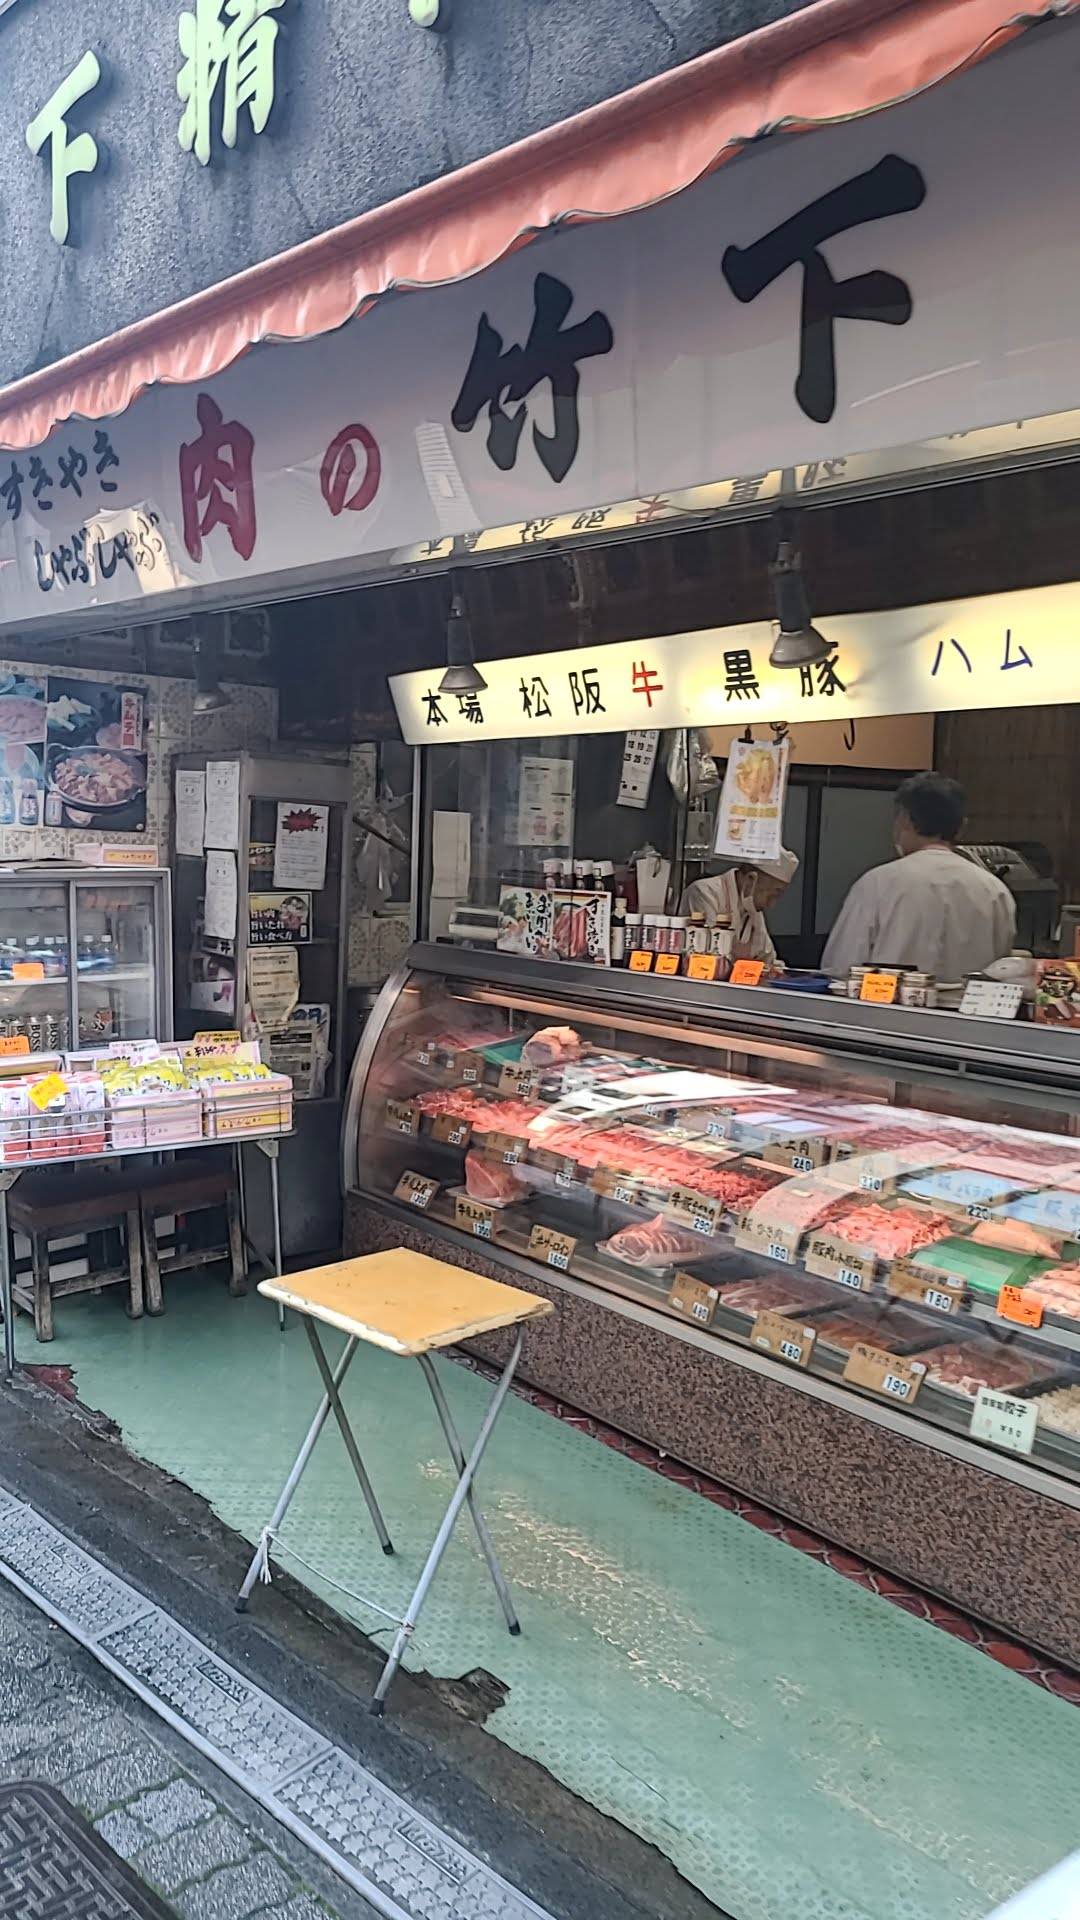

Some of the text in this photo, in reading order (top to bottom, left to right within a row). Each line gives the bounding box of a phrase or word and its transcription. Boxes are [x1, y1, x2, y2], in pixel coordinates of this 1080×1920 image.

[0, 430, 120, 520] すきやき
[724, 645, 847, 702] 黒豚
[931, 630, 1033, 676] ハム
[31, 1024, 40, 1052] BOSS
[769, 1243, 787, 1260] 160
[841, 1269, 860, 1287] 140
[886, 1376, 908, 1396] 190
